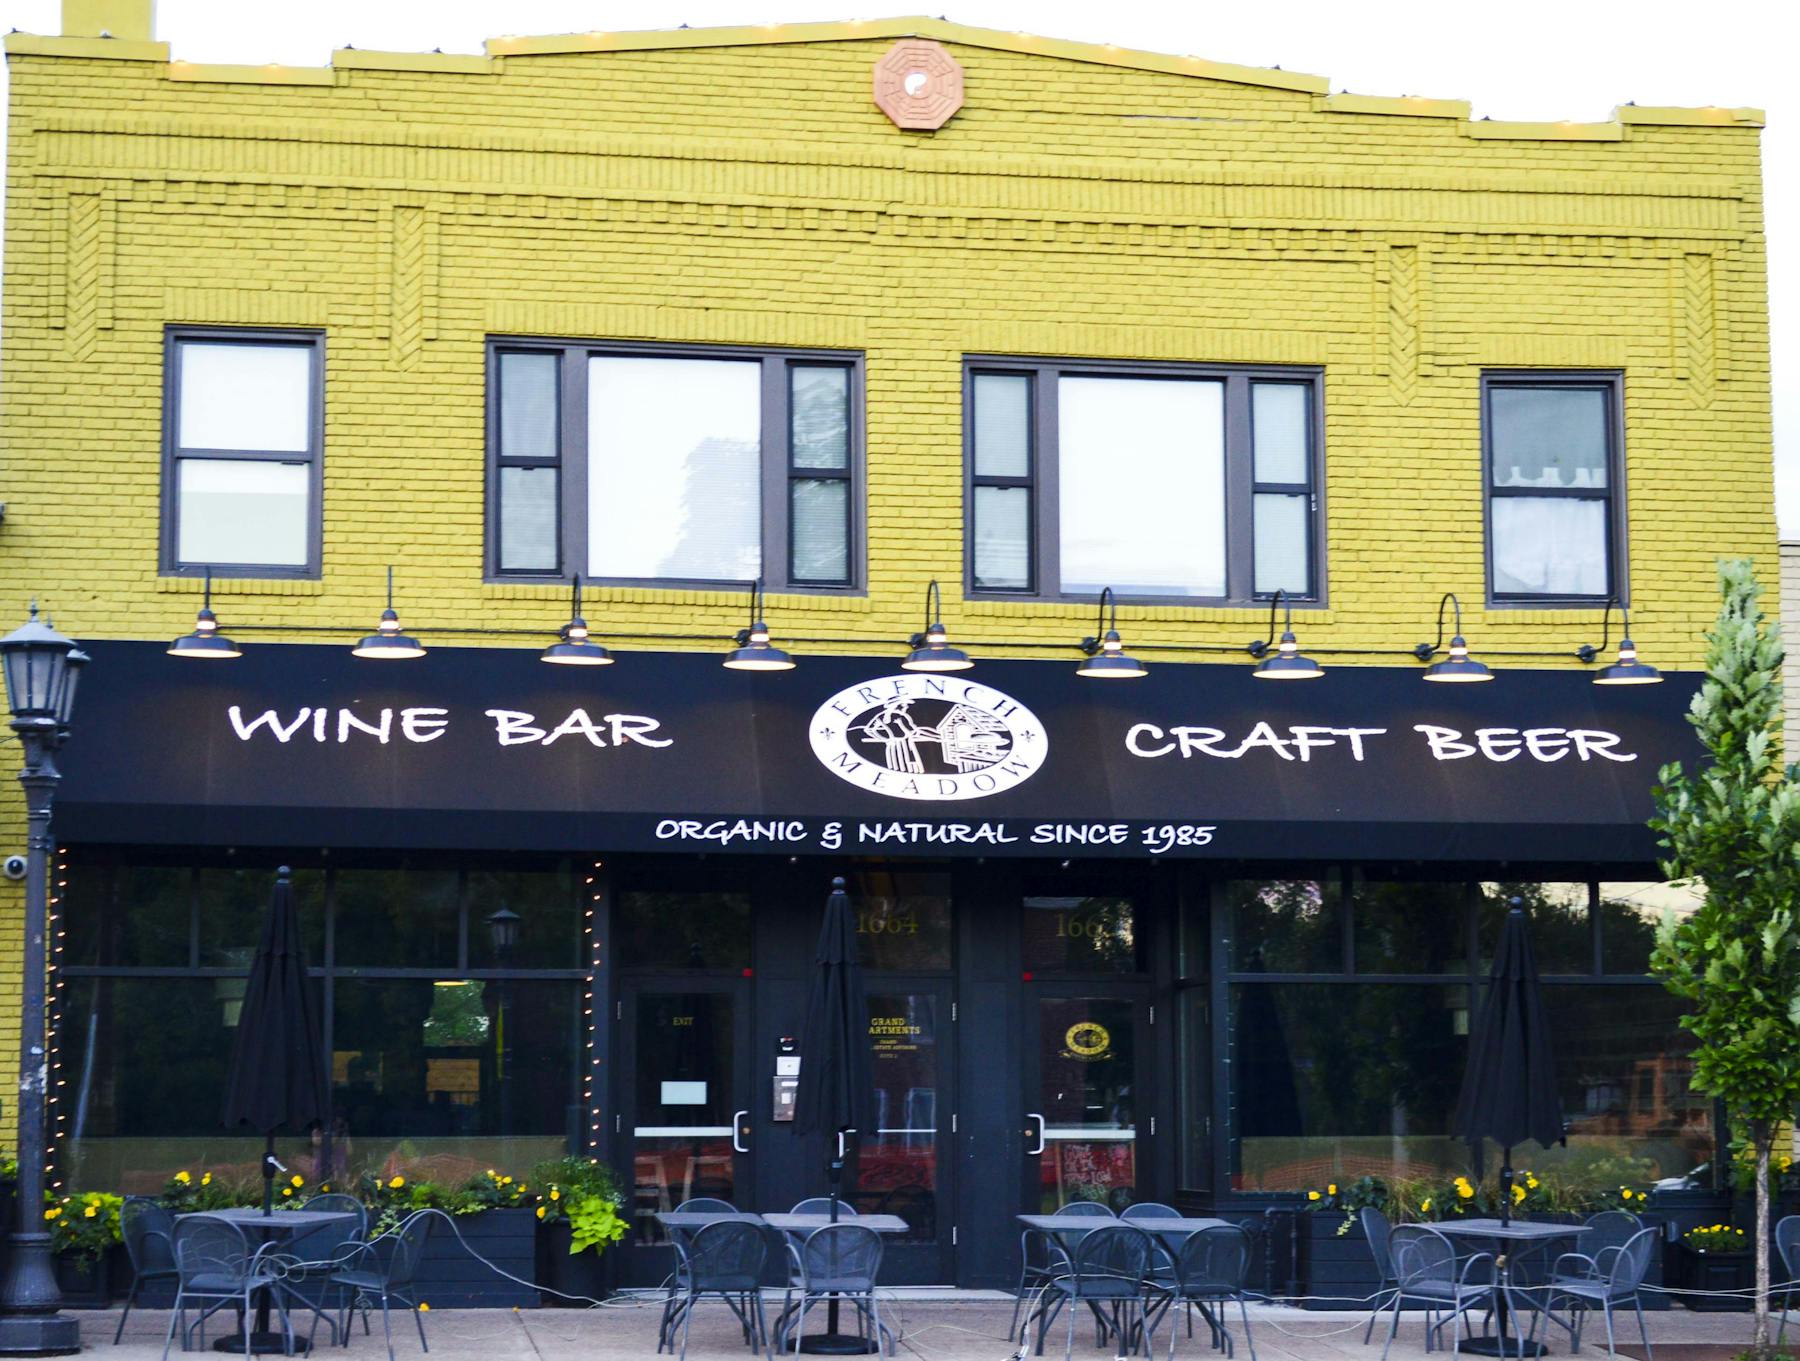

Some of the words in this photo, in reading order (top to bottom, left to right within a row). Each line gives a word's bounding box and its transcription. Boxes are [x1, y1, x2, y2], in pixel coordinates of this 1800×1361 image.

[831, 678, 1019, 718] FRENCH
[226, 704, 449, 745] WINE
[484, 707, 675, 750] BAR
[1124, 721, 1388, 763] CRAFT
[1412, 724, 1638, 764] BEER
[831, 751, 1031, 796] MEADOW
[655, 819, 808, 847] ORGANIC
[820, 821, 843, 850] &
[858, 822, 1019, 845] NATURAL
[1029, 824, 1130, 846] SINCE
[1141, 824, 1217, 854] 1985
[856, 911, 918, 936] 1664
[672, 1016, 695, 1026] EXIT
[868, 1026, 921, 1035] ARTMENTS
[871, 1017, 905, 1026] GRAND
